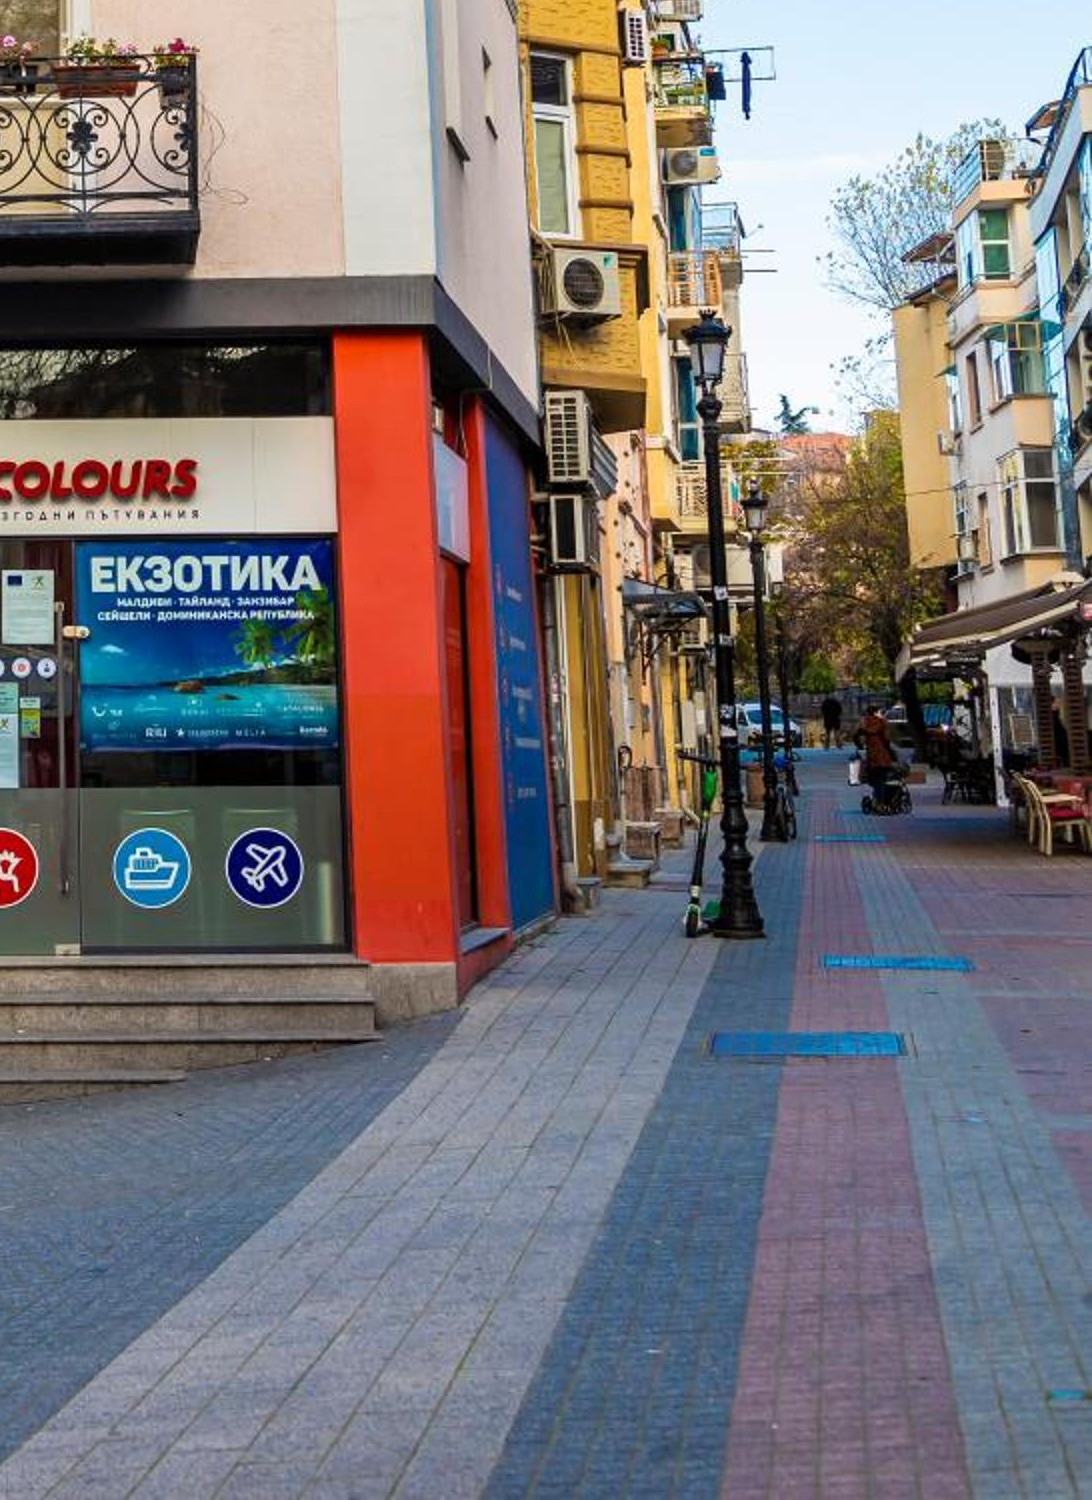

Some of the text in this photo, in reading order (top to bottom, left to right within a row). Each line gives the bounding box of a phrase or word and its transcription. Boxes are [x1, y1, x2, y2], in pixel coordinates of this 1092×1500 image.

[85, 509, 200, 521] ПЪТУВАНИЯ
[90, 555, 322, 593] ЕКЗОТИКА
[117, 595, 295, 608] МАЛДИВИ ТАЙЛАНД ЗАНЗИБАР
[97, 608, 315, 621] СЕЙШЕЛИ ДОМИНИКАНСКА РЕПУБЛИКА
